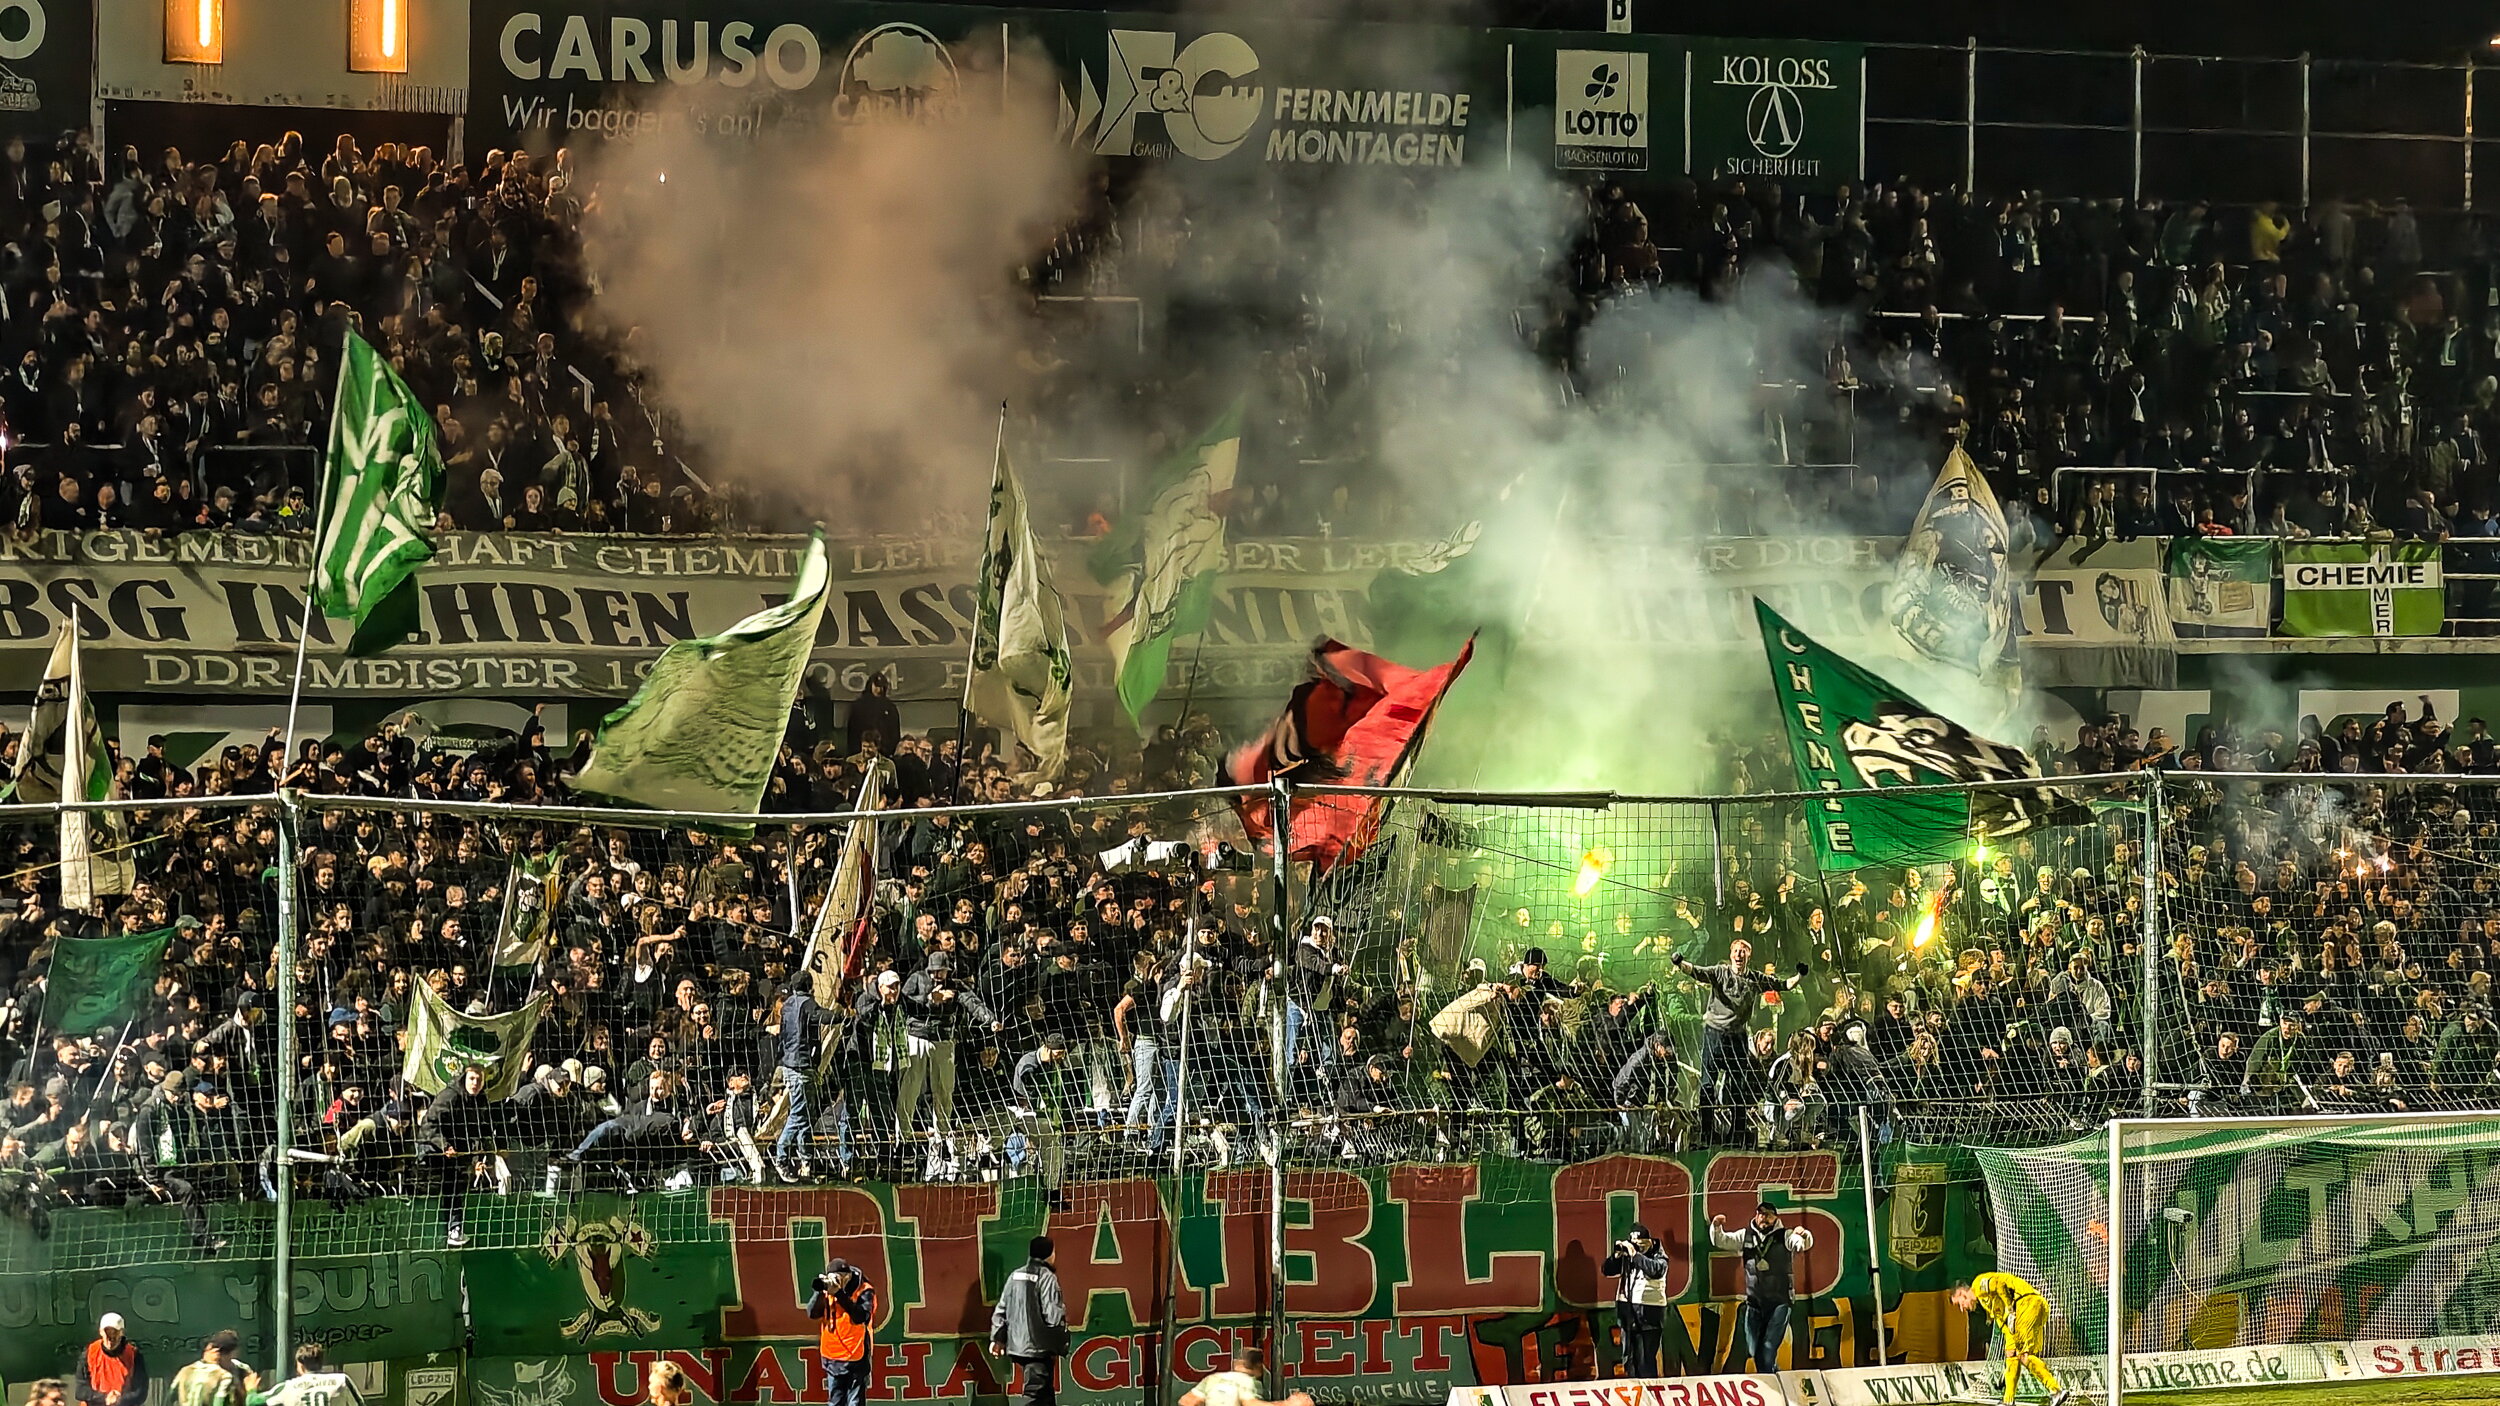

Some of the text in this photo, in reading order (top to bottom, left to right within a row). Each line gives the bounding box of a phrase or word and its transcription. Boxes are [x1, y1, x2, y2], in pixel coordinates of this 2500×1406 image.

[499, 12, 821, 90] CARUSO
[1721, 55, 1831, 87] KOLOSS
[502, 94, 556, 133] Wir
[1273, 87, 1471, 127] FERNMELDE
[1565, 110, 1639, 138] LOTTO
[1264, 128, 1465, 169] MONTAGEN
[1755, 537, 1881, 568] DICH
[2296, 566, 2424, 585] CHEMIE
[0, 578, 191, 642] BSG
[217, 580, 336, 645] IN
[404, 582, 698, 648] HREN
[706, 1151, 1845, 1343] DIABLOS
